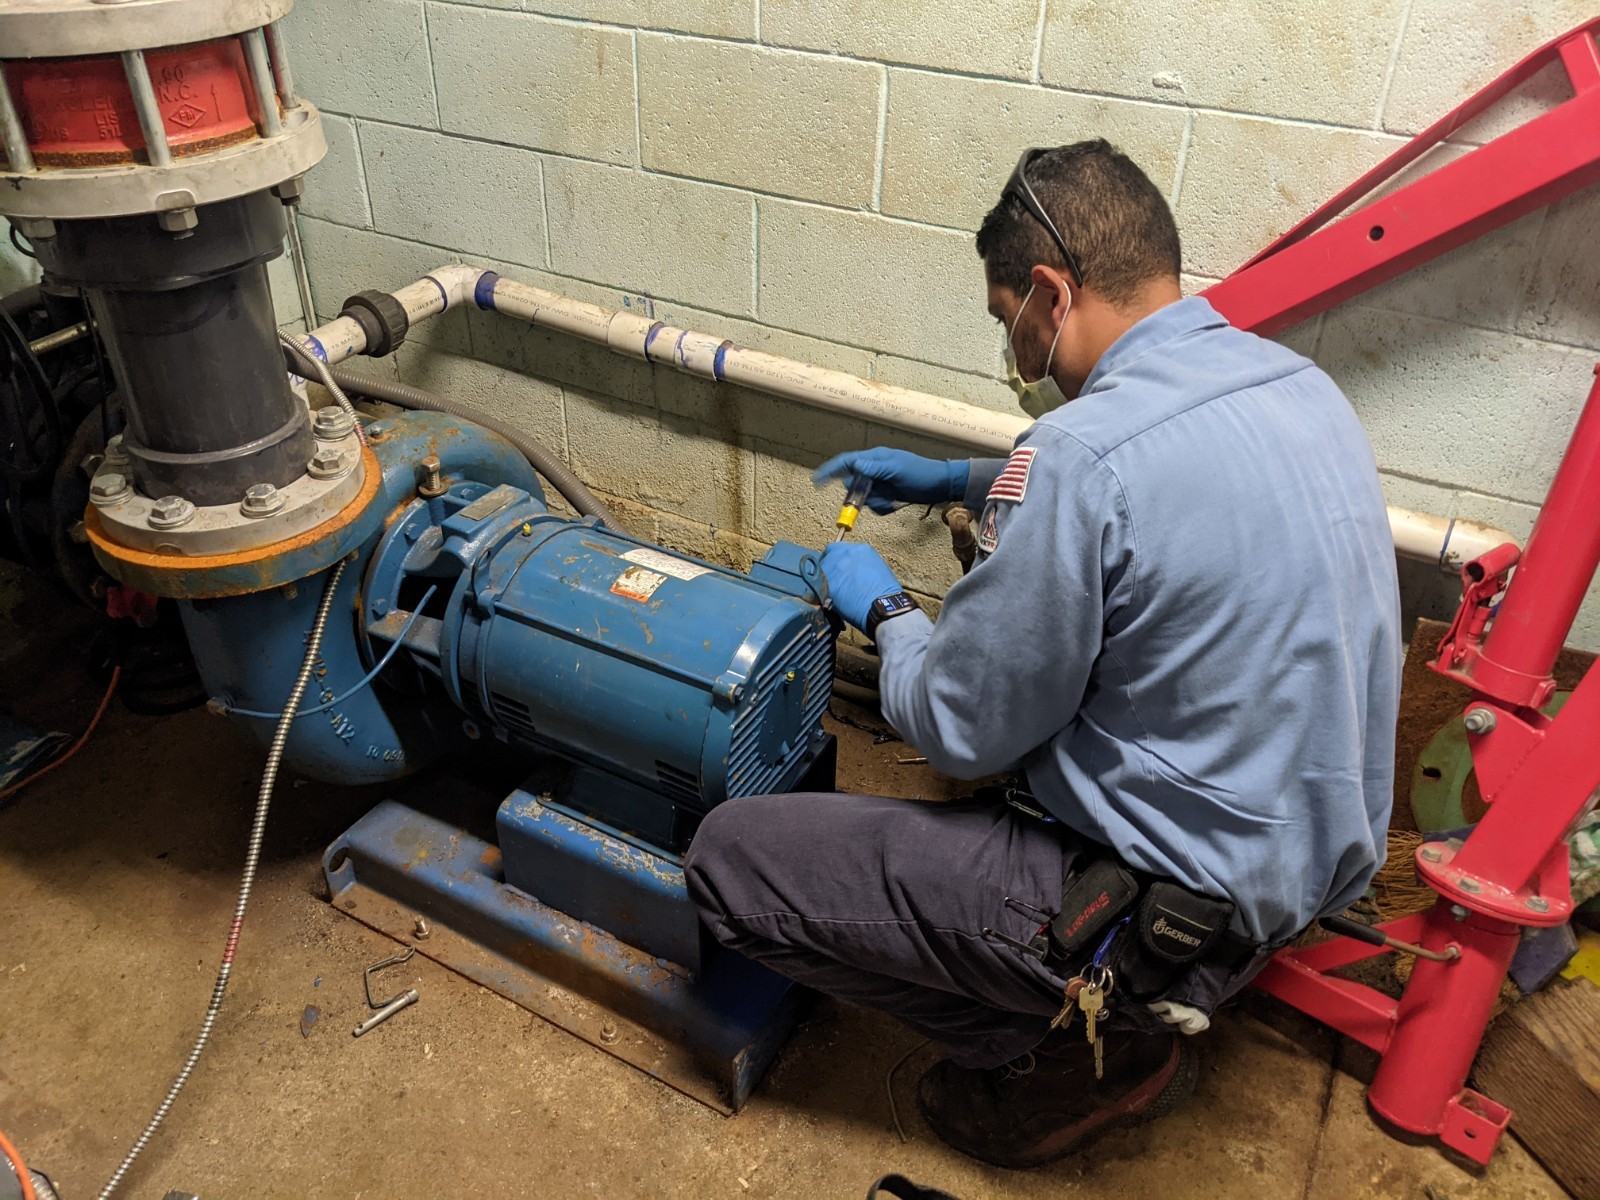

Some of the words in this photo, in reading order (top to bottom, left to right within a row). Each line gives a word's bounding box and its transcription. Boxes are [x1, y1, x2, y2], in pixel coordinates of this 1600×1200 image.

[931, 413, 976, 430] PLASTICS
[978, 426, 1016, 441] PACIFIC
[1163, 925, 1201, 948] GERBER
